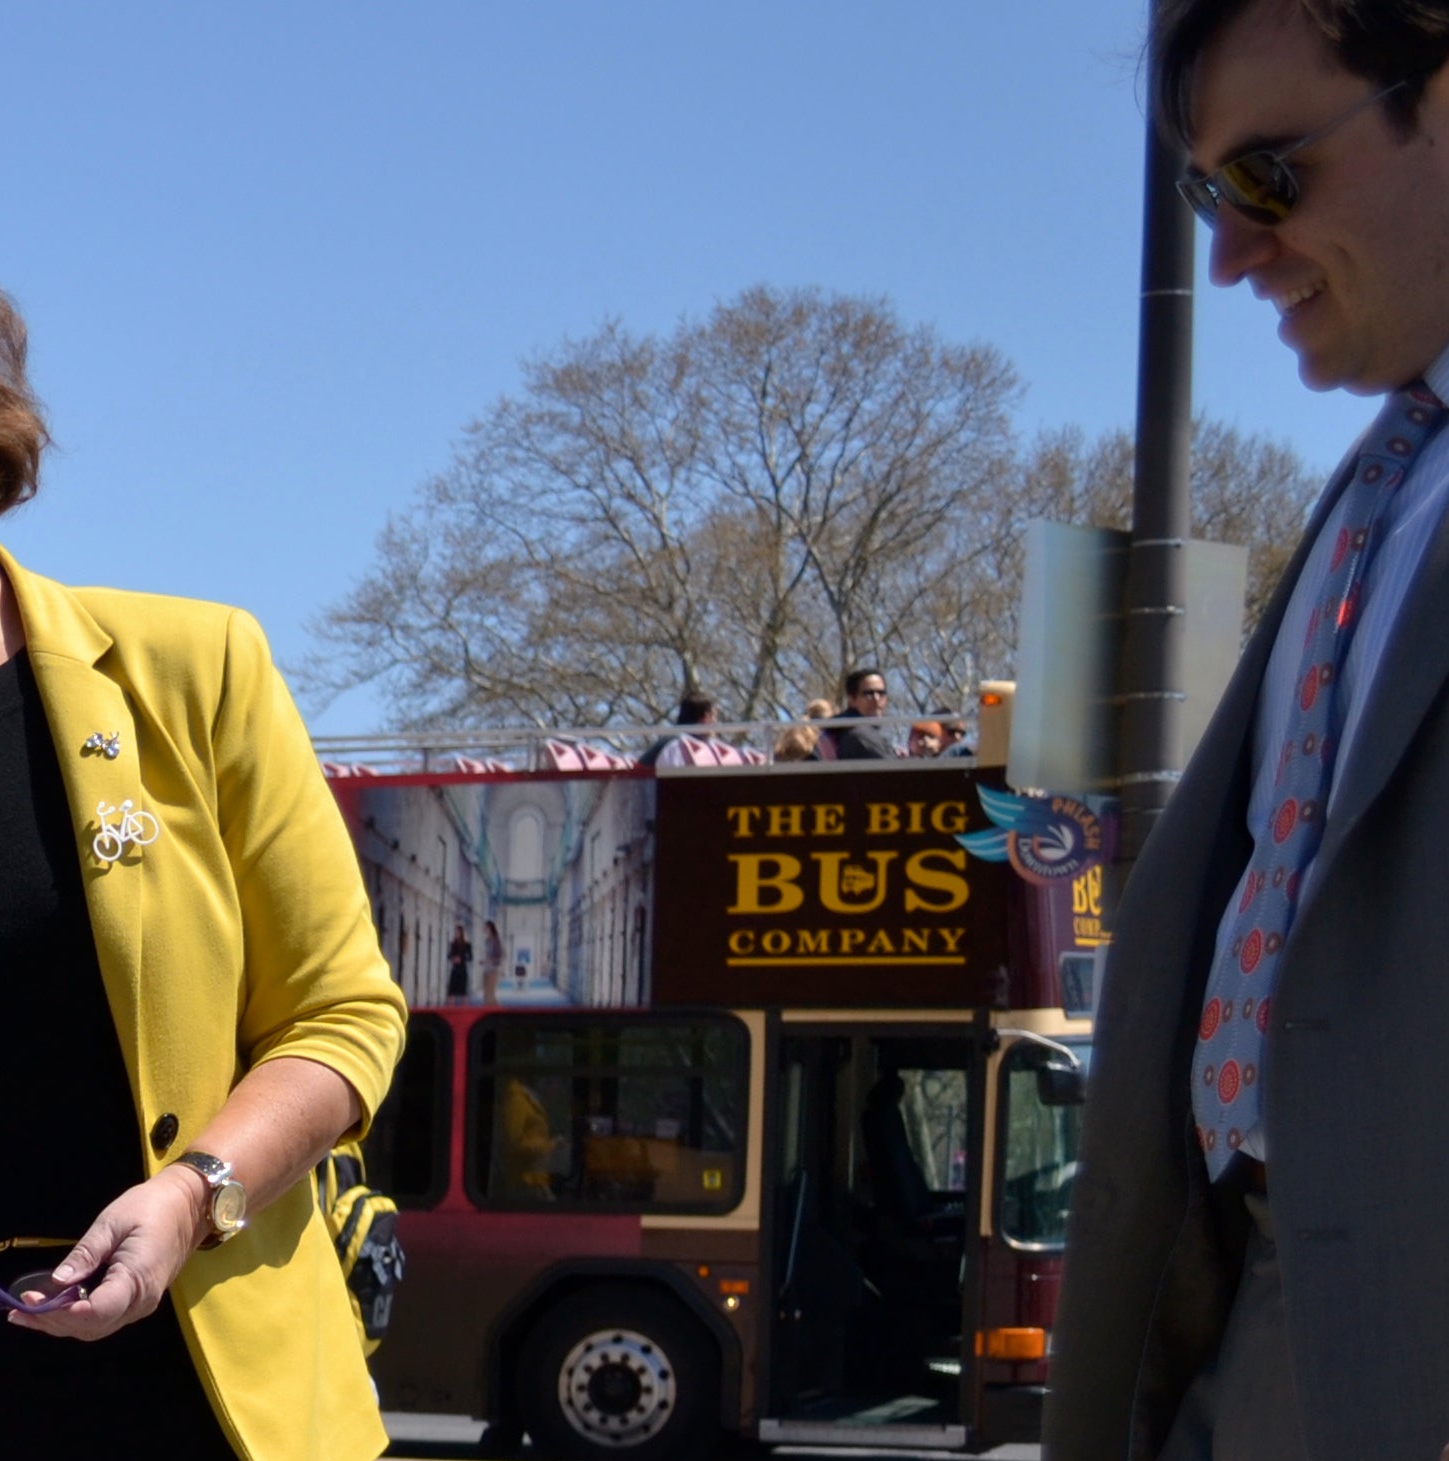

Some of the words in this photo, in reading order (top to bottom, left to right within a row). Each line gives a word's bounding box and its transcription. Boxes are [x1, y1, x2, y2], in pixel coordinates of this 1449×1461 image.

[727, 805, 845, 837] THE
[866, 801, 968, 834] BIG
[726, 849, 970, 914] BUS
[728, 928, 965, 954] COMPANY
